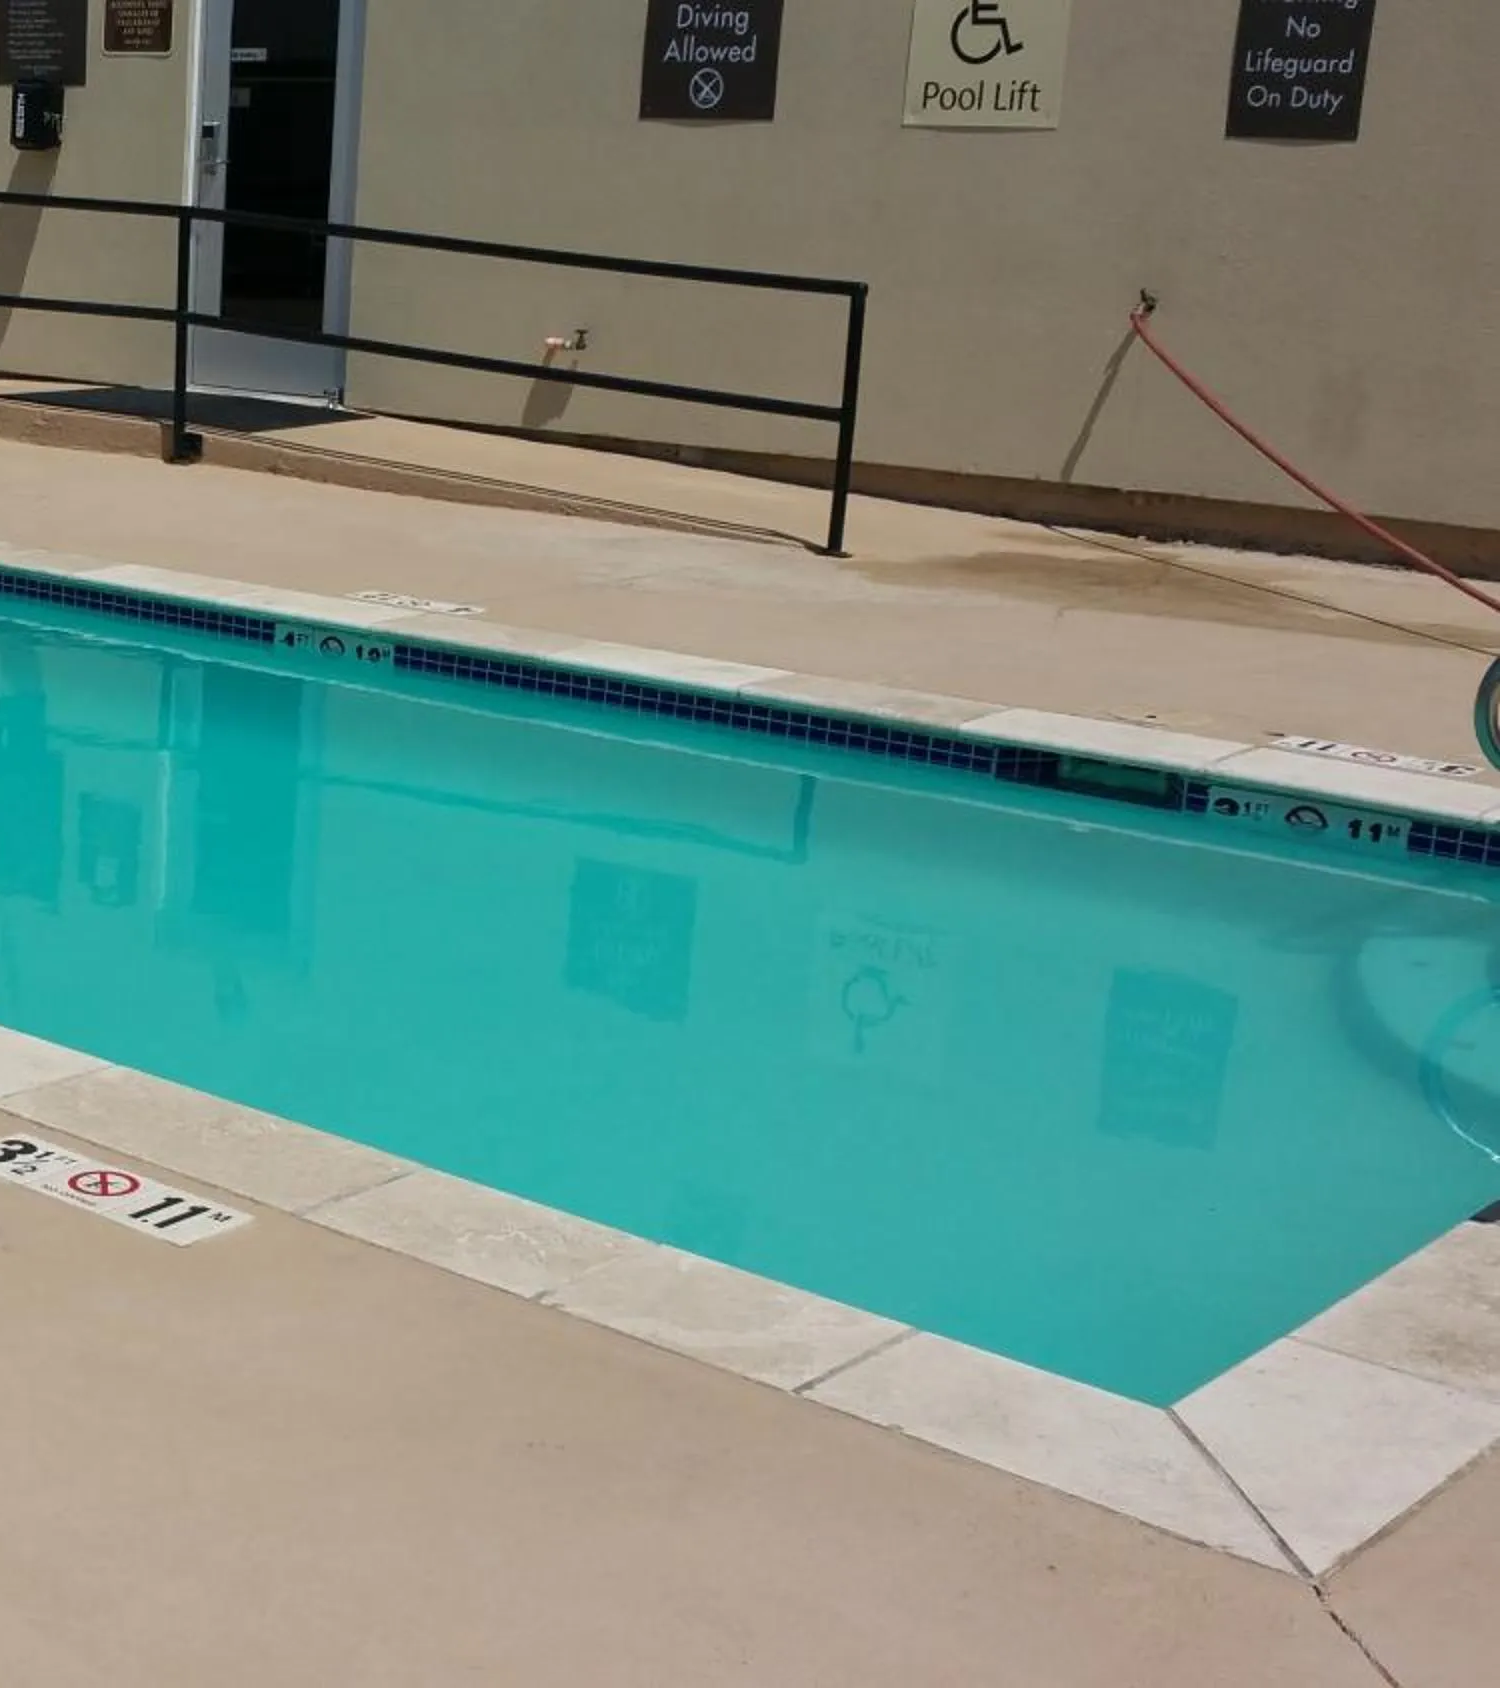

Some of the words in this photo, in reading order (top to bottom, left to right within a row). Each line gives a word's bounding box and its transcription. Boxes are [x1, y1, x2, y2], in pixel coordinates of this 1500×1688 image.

[676, 4, 749, 35] Diving
[1285, 15, 1321, 38] No
[662, 34, 757, 62] Allowed
[1245, 48, 1355, 80] Lifeguard
[922, 80, 985, 111] Pool
[993, 80, 1041, 112] Lift
[1247, 85, 1281, 108] On
[1290, 86, 1344, 116] Duty
[128, 1197, 211, 1229] 1.1
